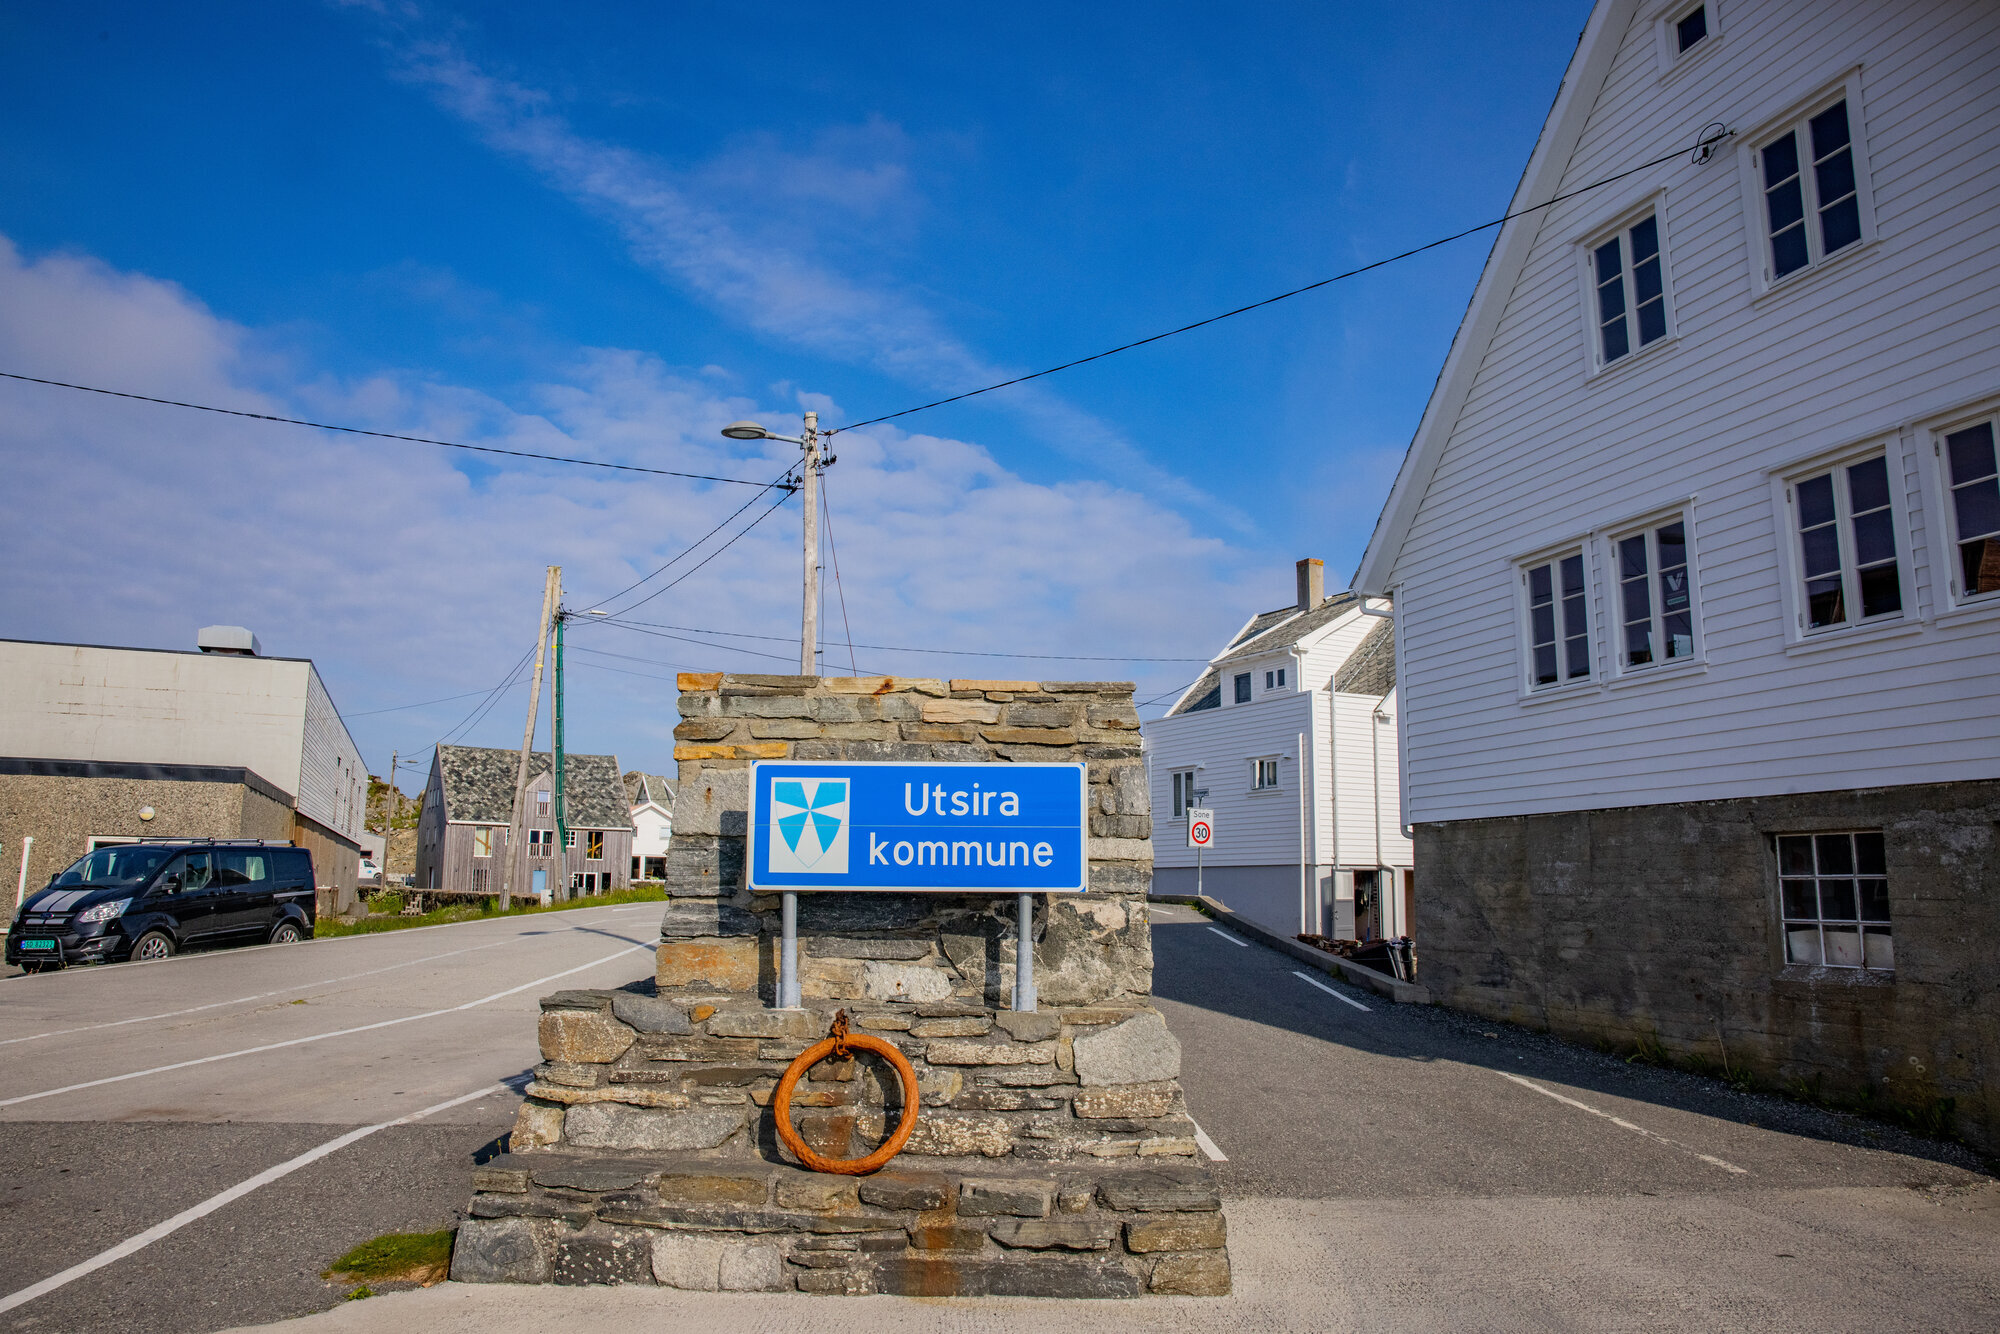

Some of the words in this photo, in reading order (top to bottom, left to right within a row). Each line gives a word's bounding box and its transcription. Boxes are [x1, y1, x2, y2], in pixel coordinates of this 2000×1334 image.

[904, 782, 1020, 817] Utsira
[1193, 810, 1210, 819] Sone
[1195, 827, 1208, 839] 30
[869, 832, 1054, 867] kommune
